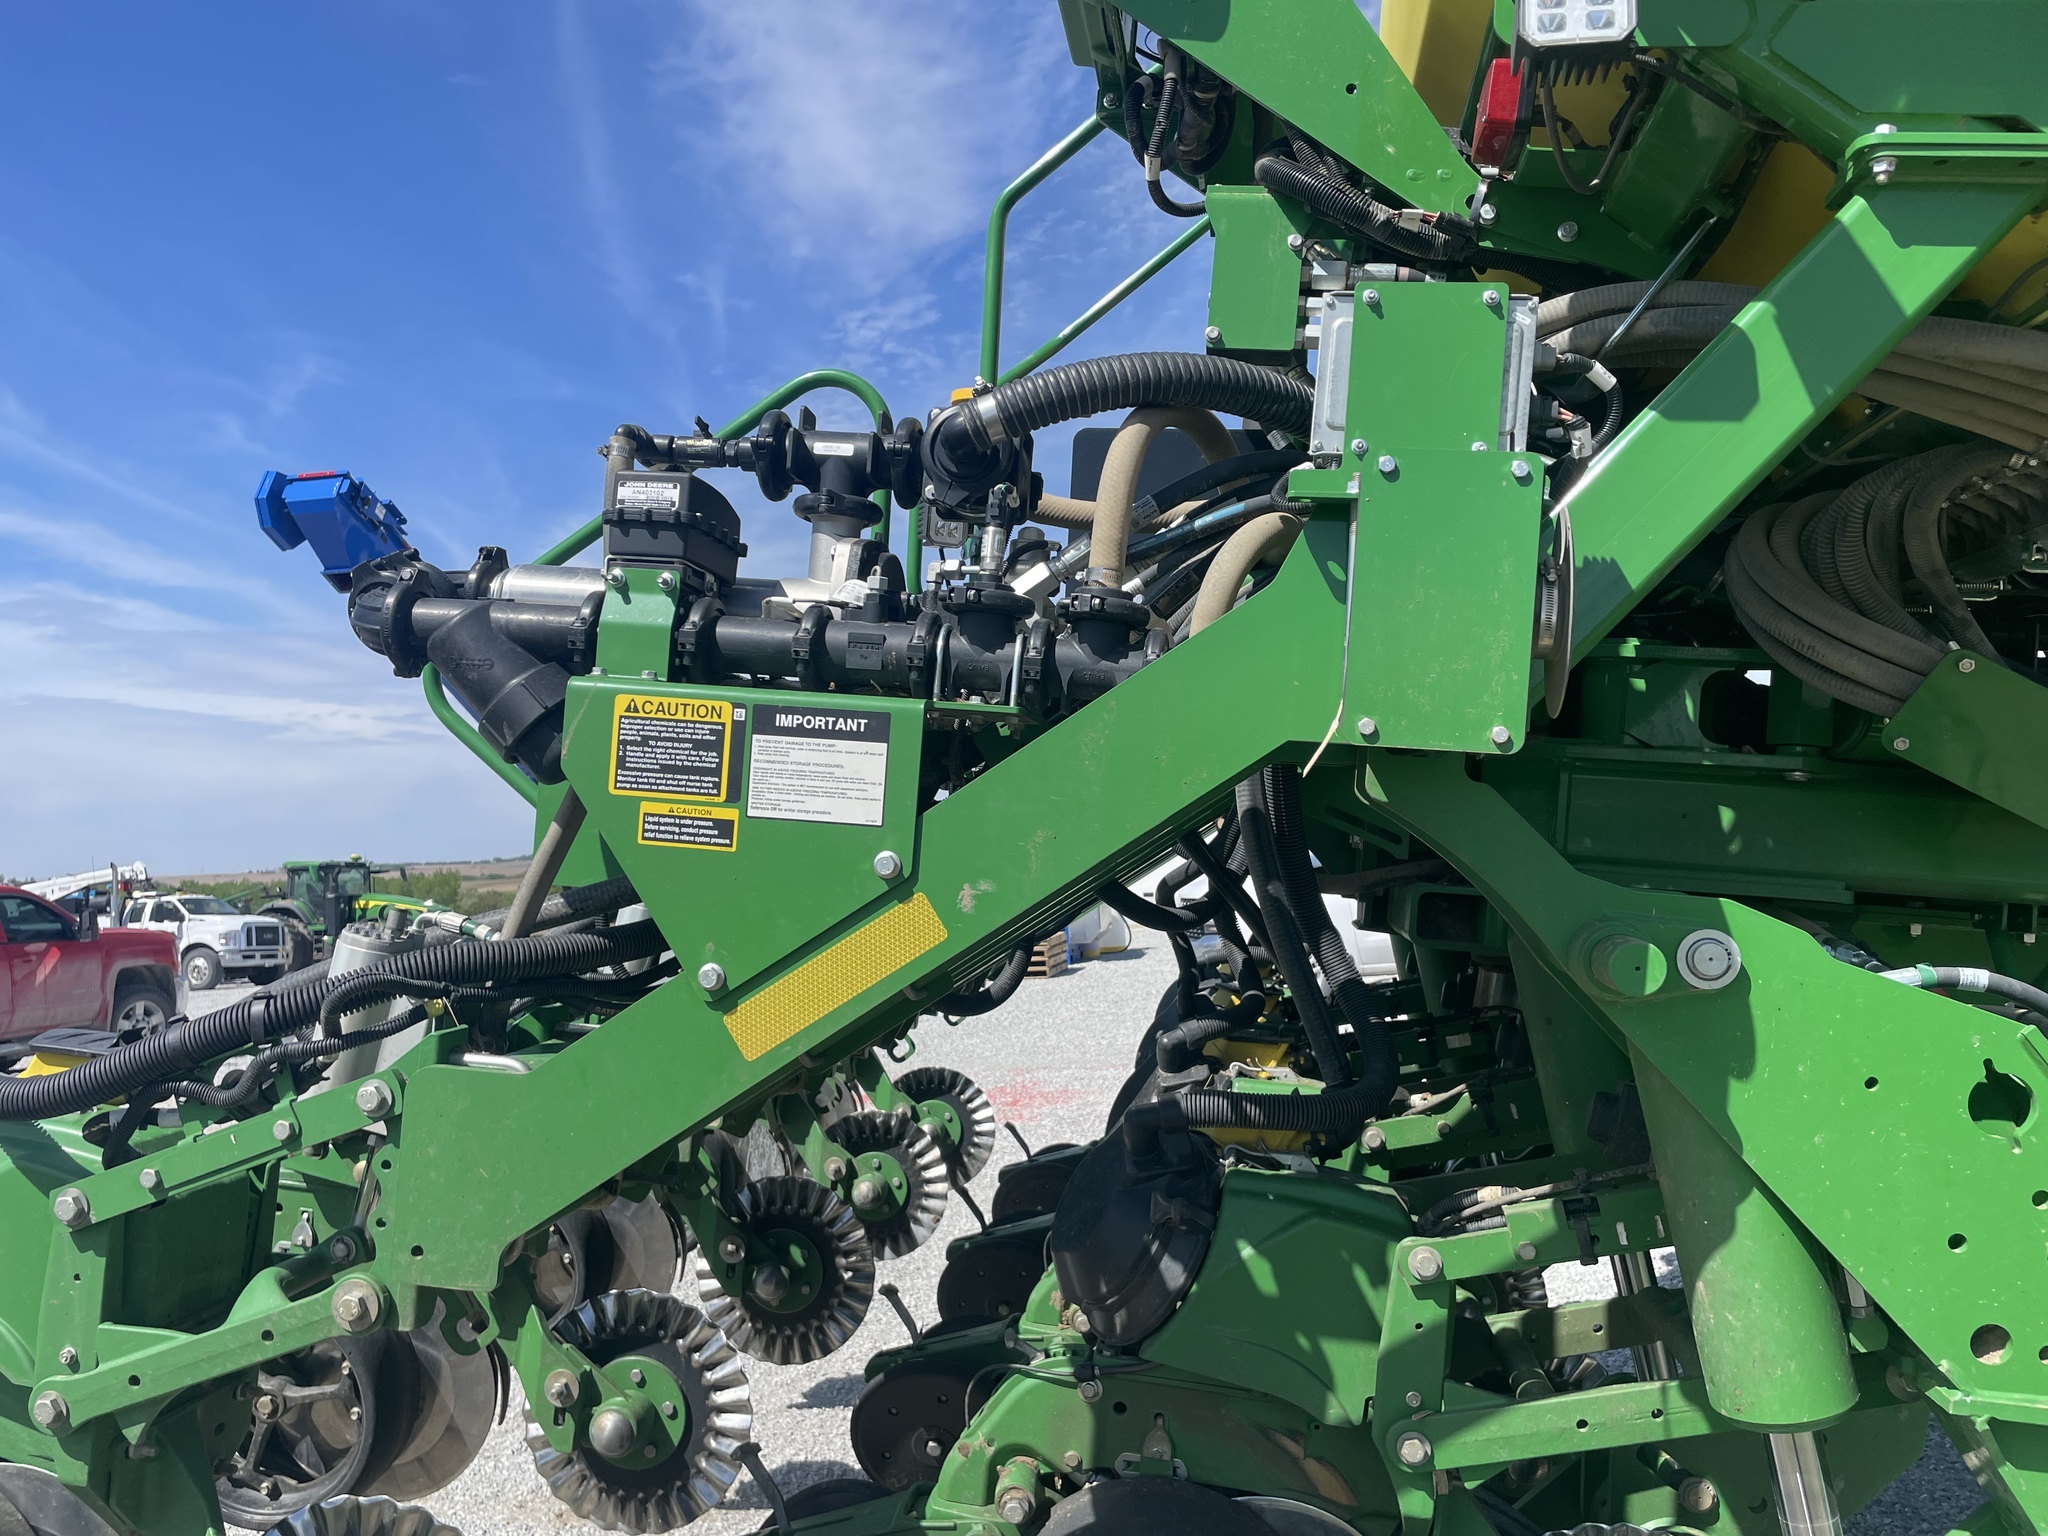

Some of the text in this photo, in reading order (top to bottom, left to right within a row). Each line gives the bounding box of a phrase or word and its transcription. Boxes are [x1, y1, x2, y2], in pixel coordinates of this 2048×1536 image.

[642, 700, 722, 719] CAUTION
[776, 714, 868, 732] IMPORTANT
[676, 807, 712, 816] CAUTION
[659, 824, 680, 832] servicing,
